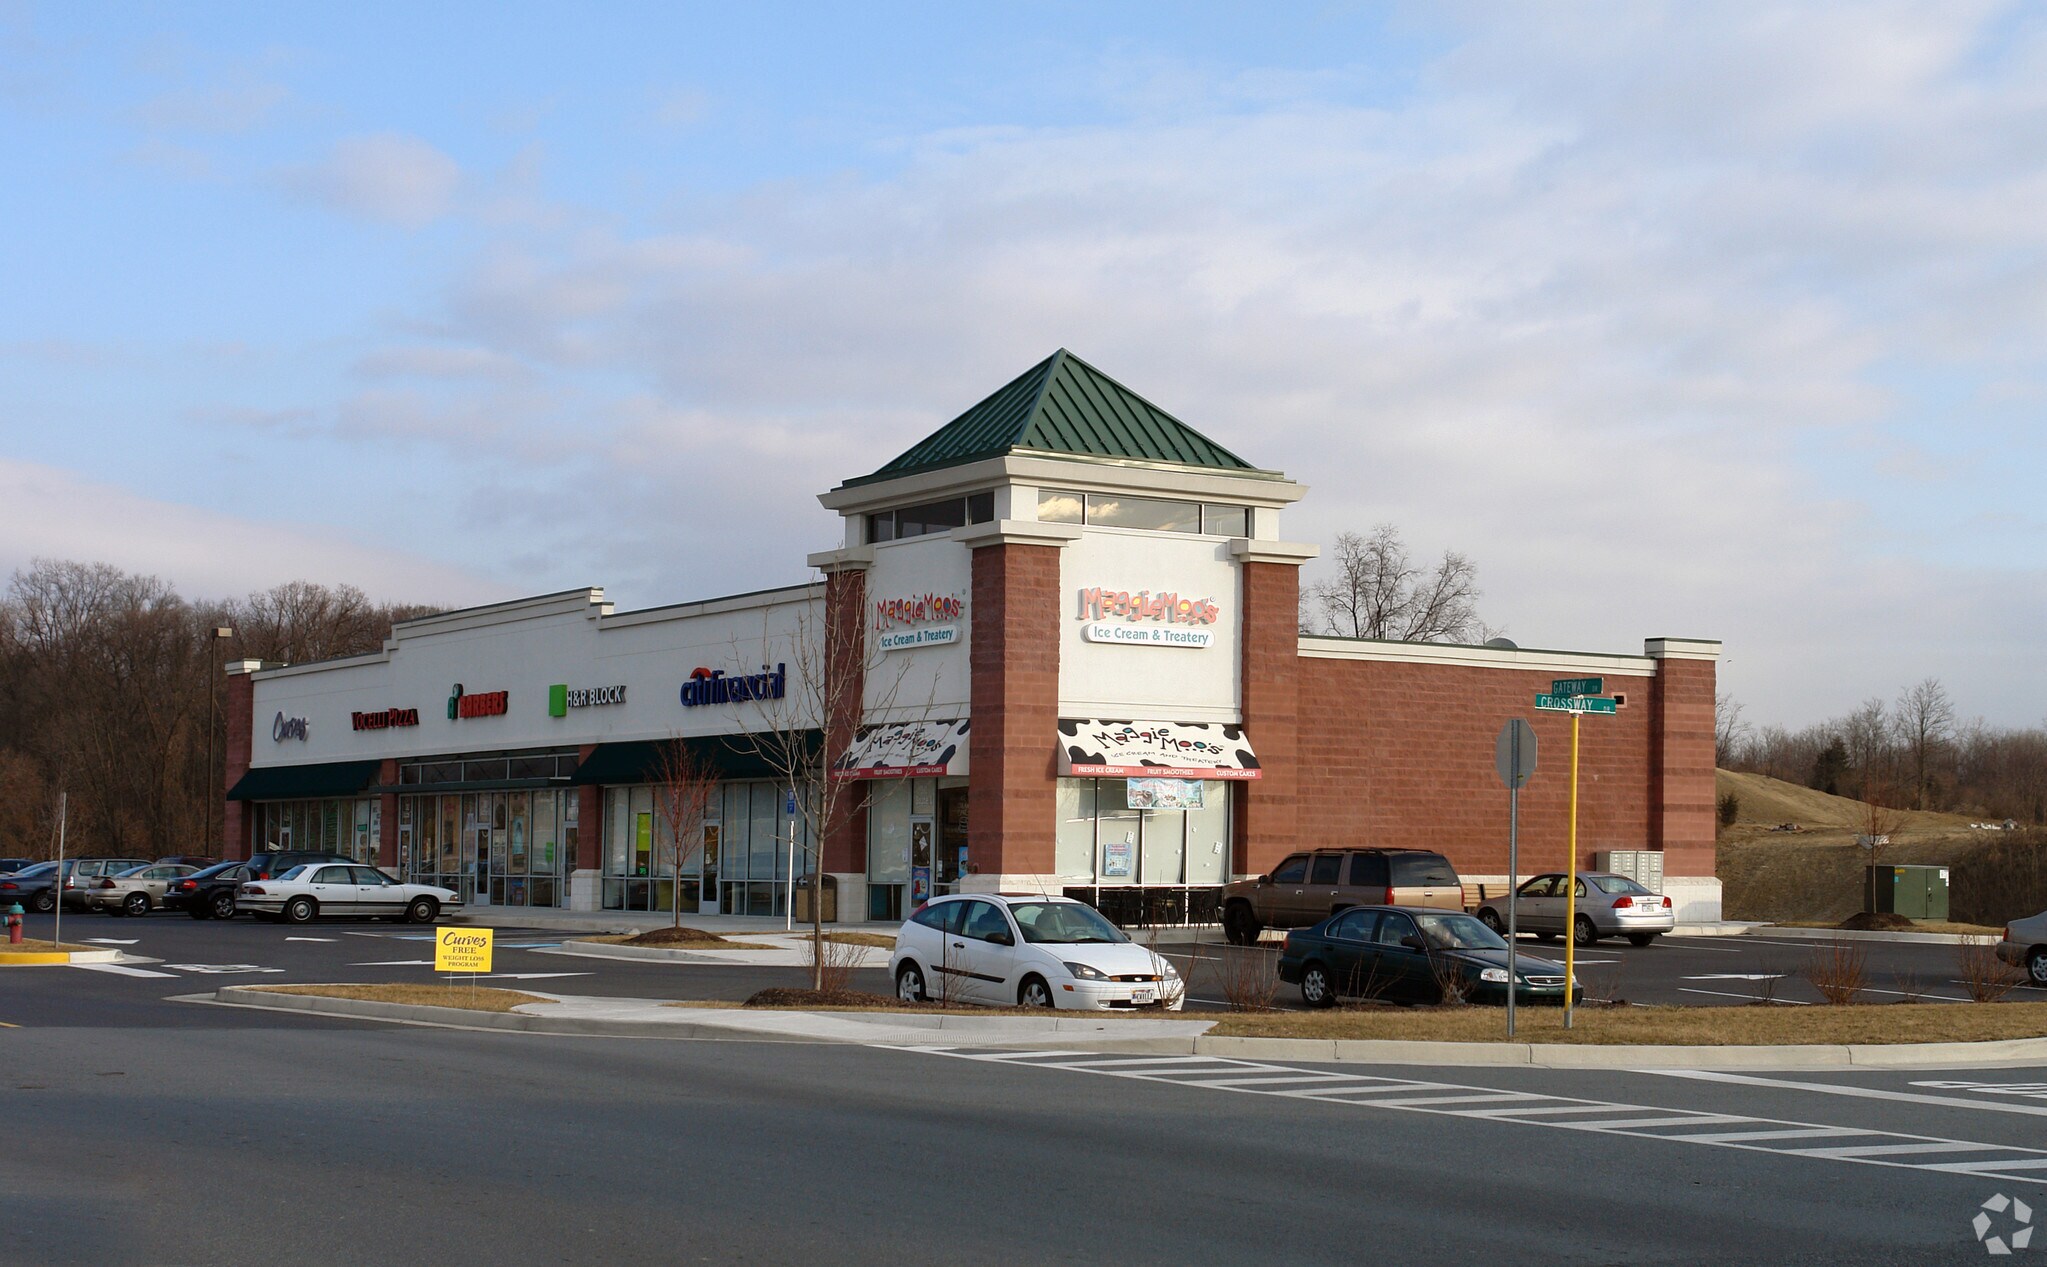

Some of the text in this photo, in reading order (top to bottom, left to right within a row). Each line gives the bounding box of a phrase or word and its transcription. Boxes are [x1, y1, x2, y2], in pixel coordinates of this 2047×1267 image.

[876, 592, 961, 630] MaggieMoo's
[1076, 587, 1219, 625] MaggieMoo's
[881, 628, 953, 647] Ice Cream & Treatery
[1094, 626, 1209, 645] Ice Cream & Treatery
[566, 685, 626, 708] H&R BLOCK
[1554, 681, 1586, 694] GATEWAY
[459, 691, 508, 719] BARBERS
[1541, 697, 1593, 710] CROSSWAY
[351, 708, 419, 730] VOCELLI PIZZA
[1093, 727, 1169, 749] Maggie
[1160, 737, 1223, 755] Moo's
[1078, 766, 1095, 774] FRESH
[443, 931, 486, 947] Curves
